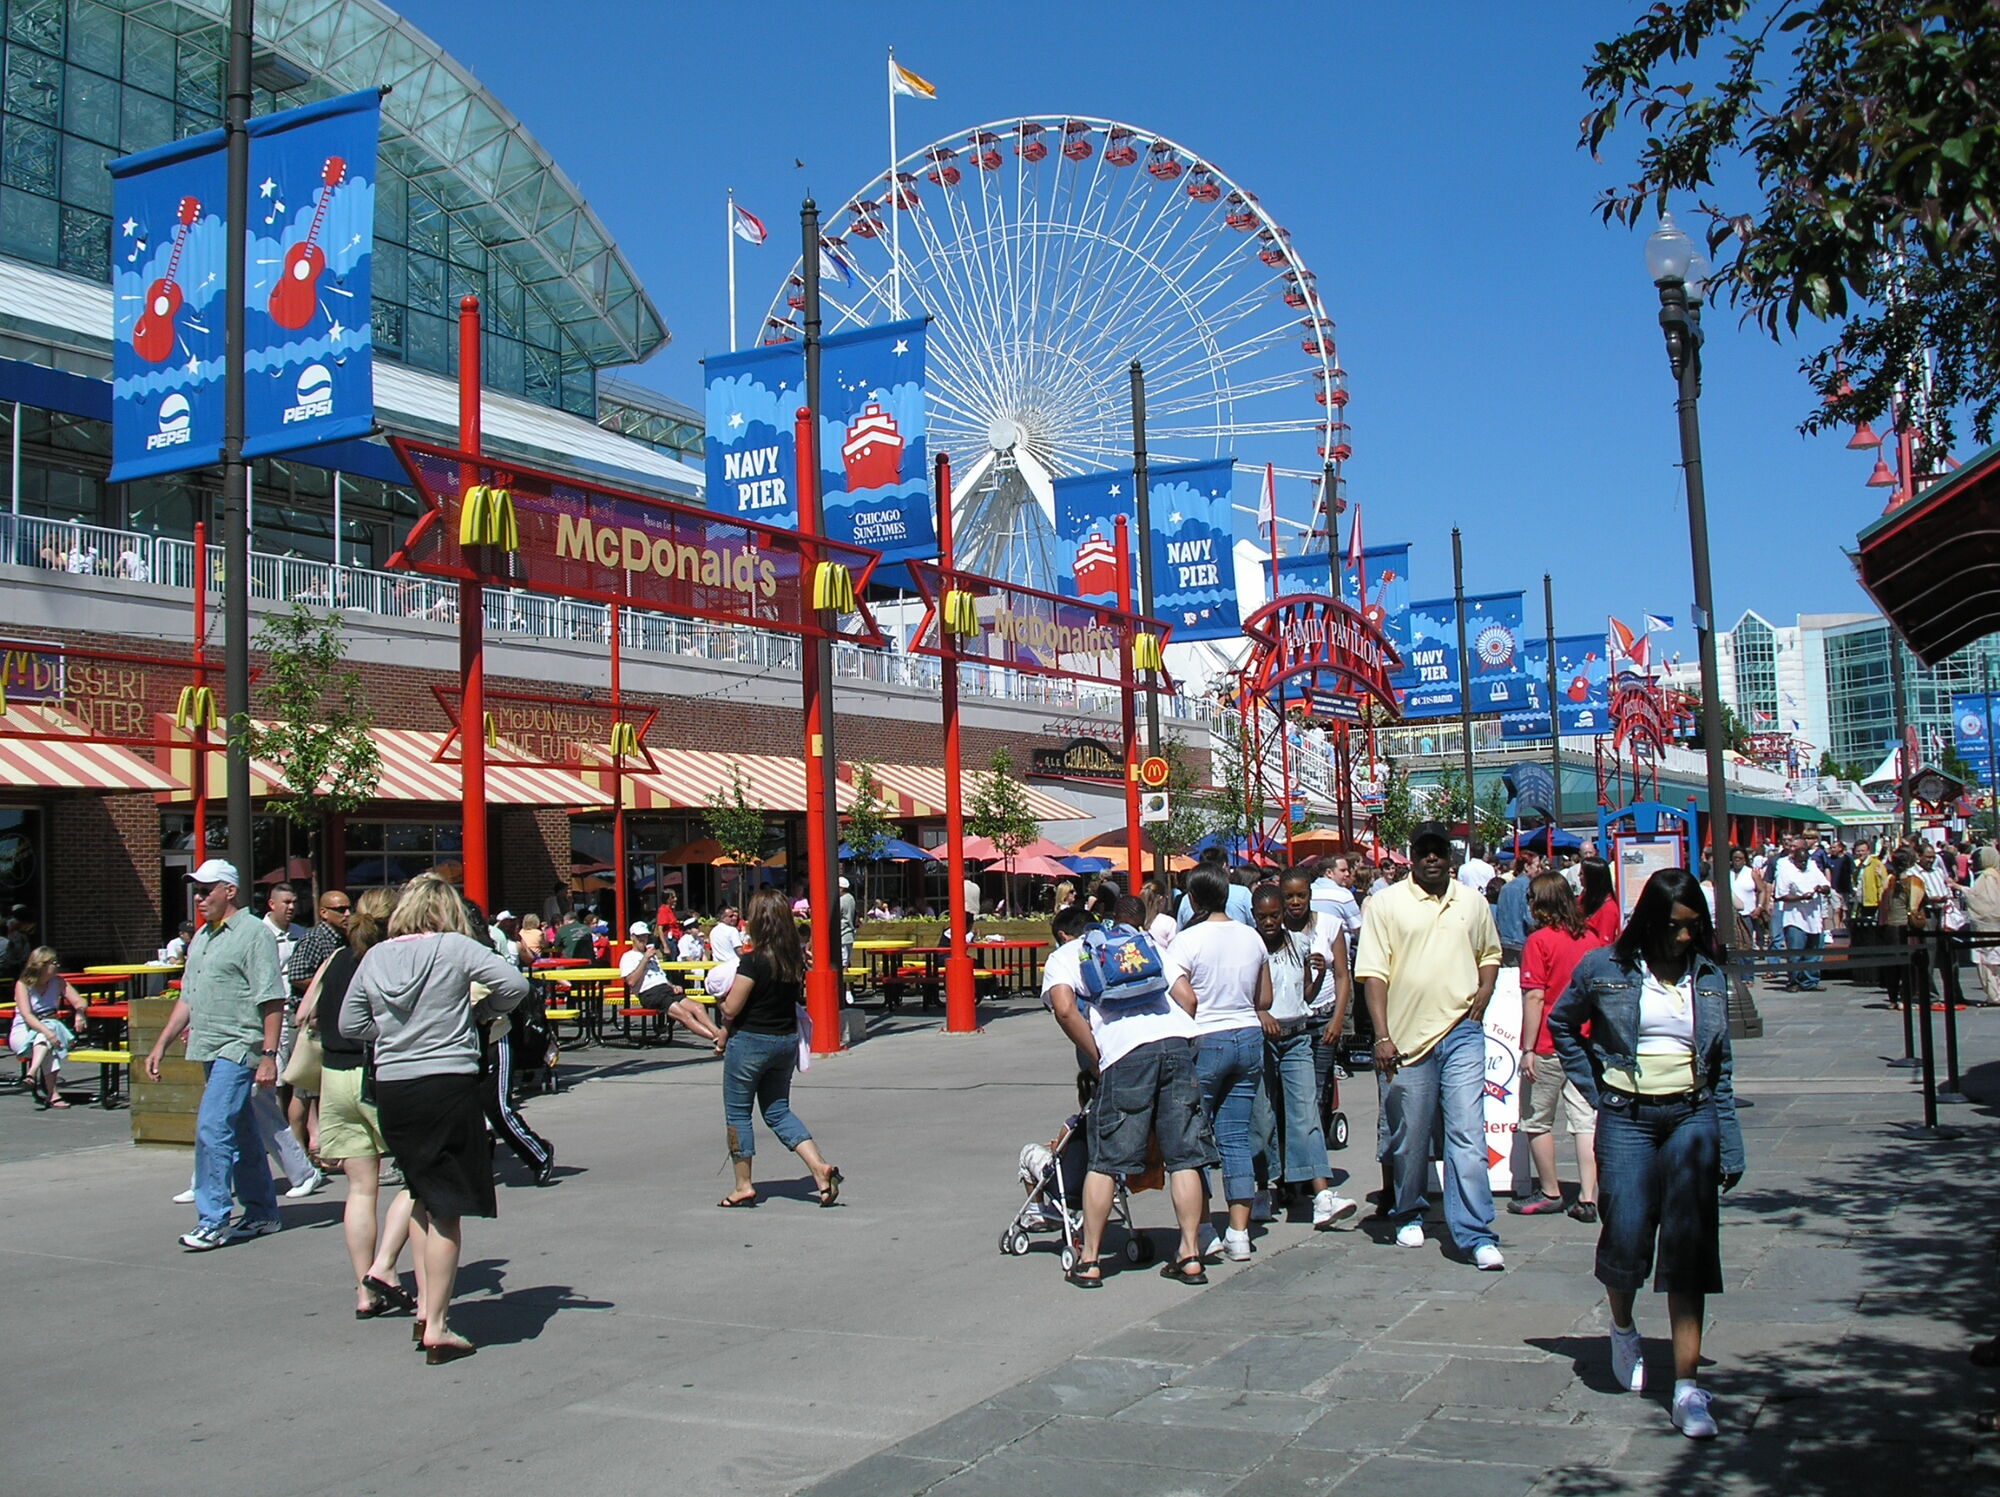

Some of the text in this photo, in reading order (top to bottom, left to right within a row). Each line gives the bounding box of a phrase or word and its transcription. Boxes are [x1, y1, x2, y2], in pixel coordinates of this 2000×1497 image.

[283, 399, 333, 424] PEPSI
[146, 427, 191, 450] PEPSI
[724, 446, 779, 481] NAVY
[737, 478, 787, 511] PIER
[855, 509, 901, 526] CHICAGO
[853, 521, 906, 540] SUN-TIMES
[555, 512, 777, 598] McDonald's
[1167, 539, 1212, 564] NAVY
[1178, 563, 1219, 588] PIER
[995, 607, 1115, 661] McDonald's
[1284, 618, 1381, 672] FAMILY PAVILION
[1412, 649, 1443, 667] NAVY
[1420, 665, 1448, 682] PIER
[1492, 1023, 1516, 1041] Tour
